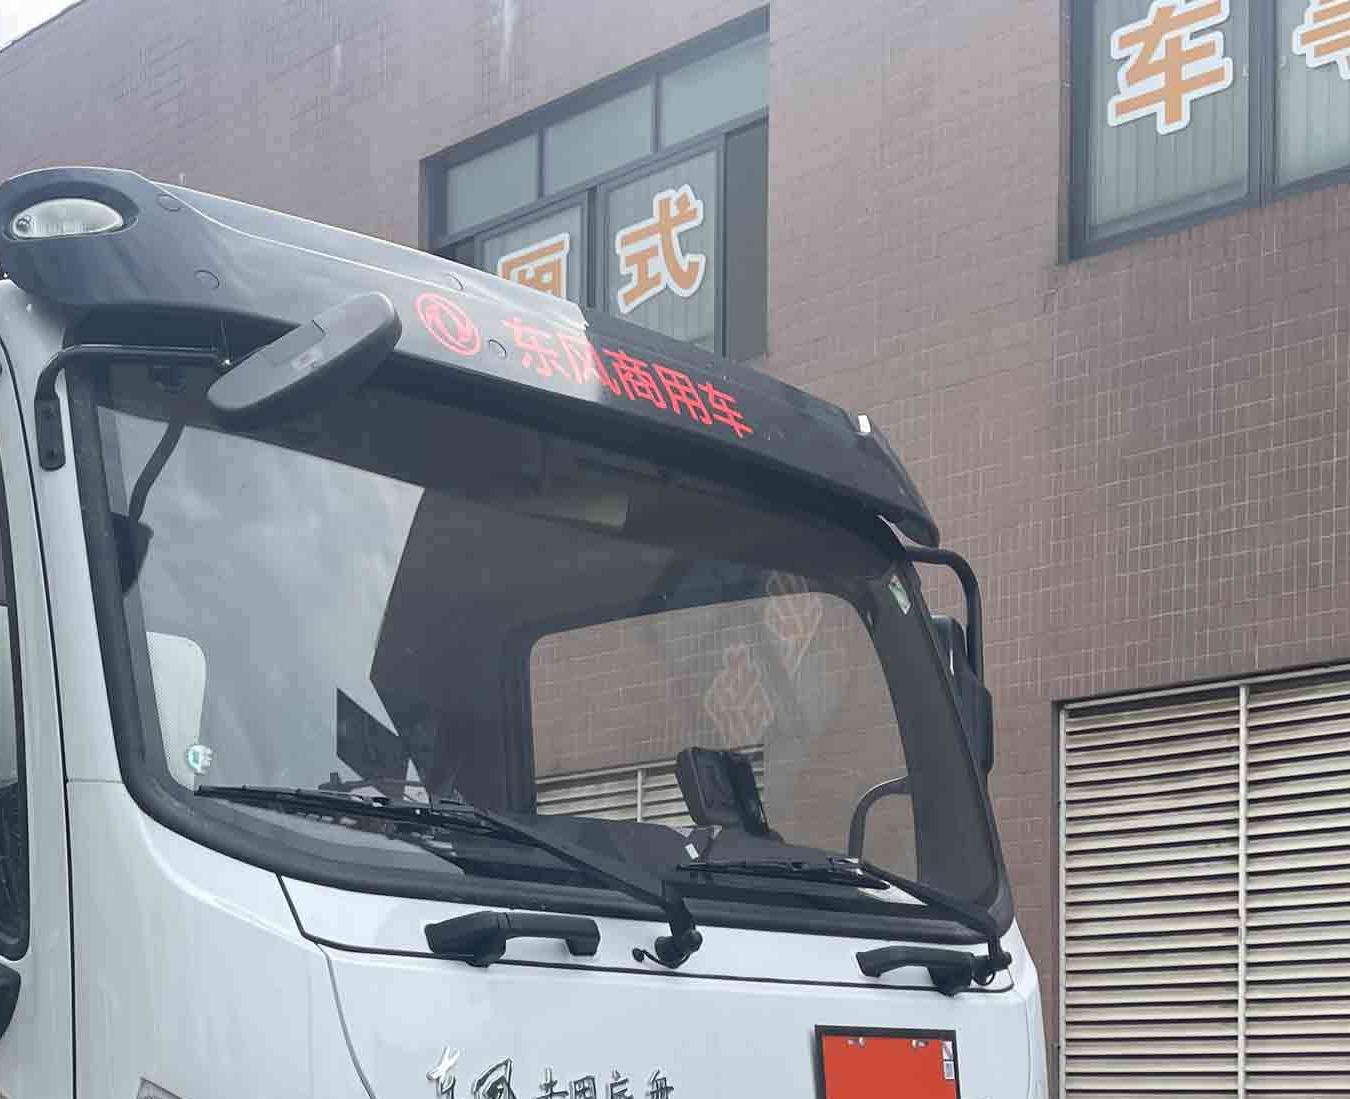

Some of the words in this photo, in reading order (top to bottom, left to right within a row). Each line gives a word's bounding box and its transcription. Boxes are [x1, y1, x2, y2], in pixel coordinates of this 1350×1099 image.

[502, 315, 753, 438] 东风商用车
